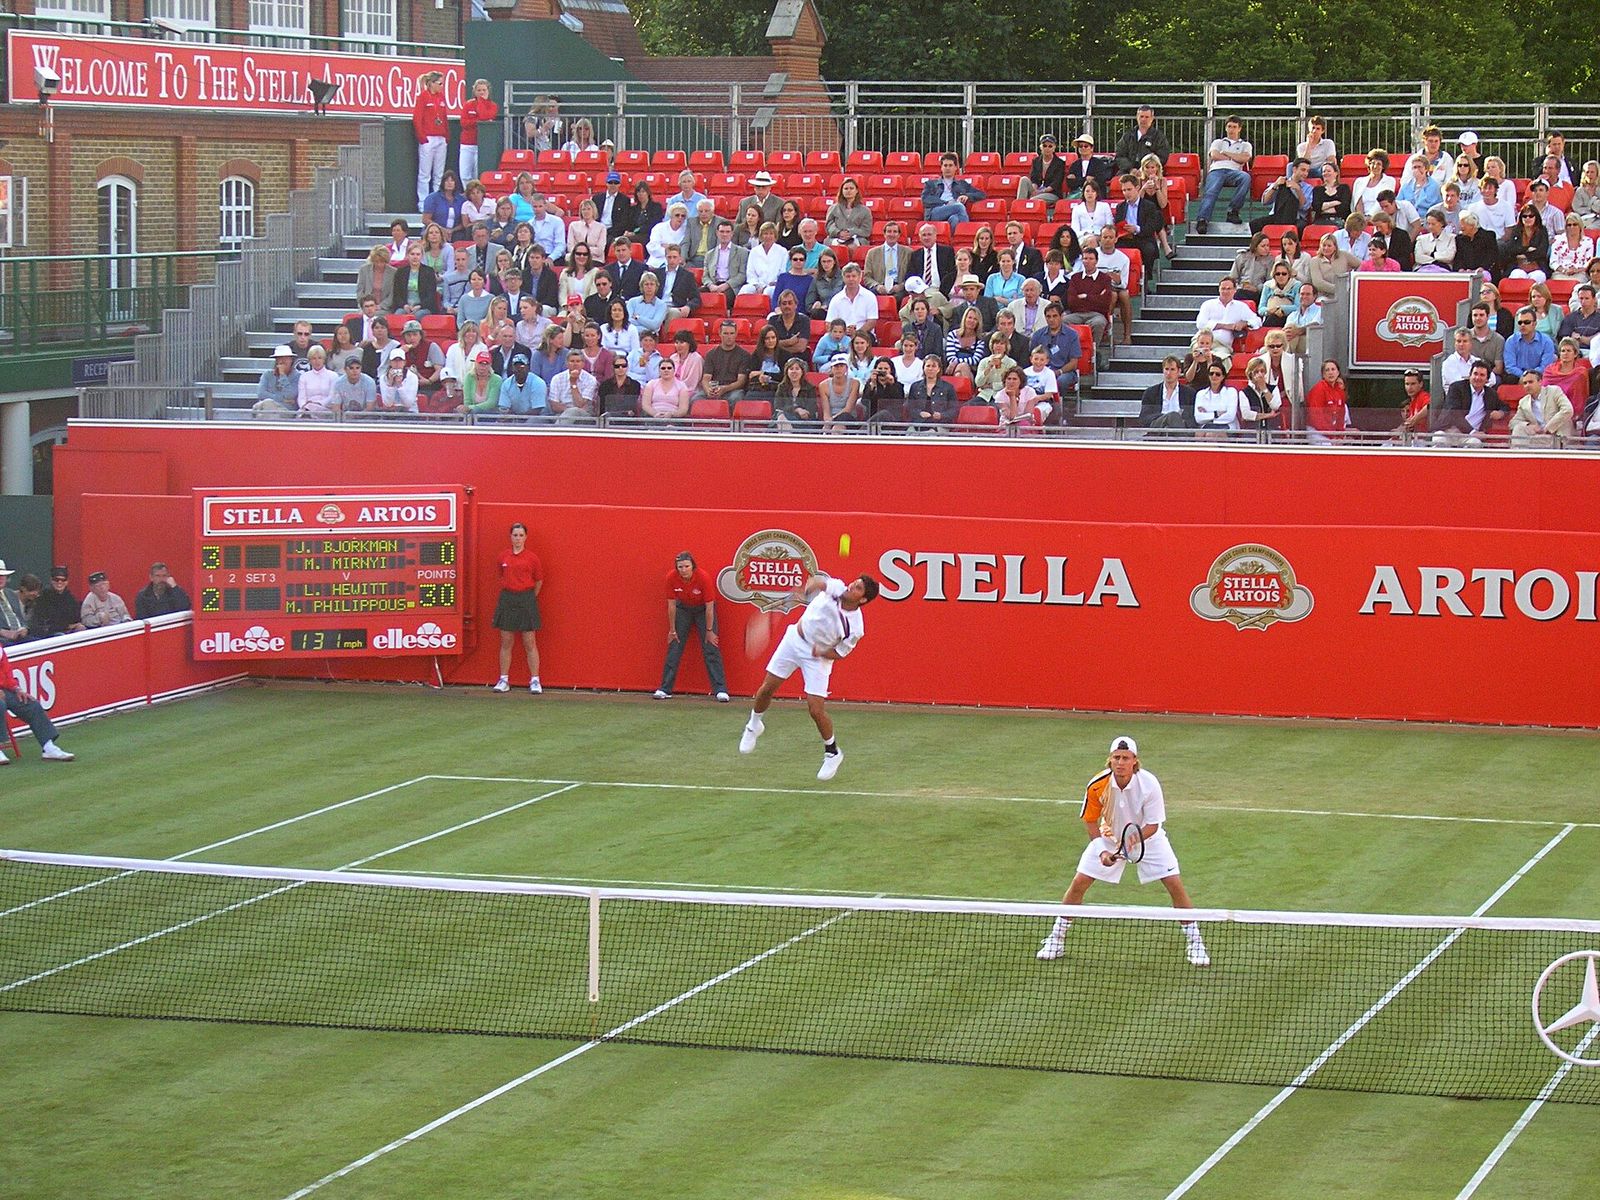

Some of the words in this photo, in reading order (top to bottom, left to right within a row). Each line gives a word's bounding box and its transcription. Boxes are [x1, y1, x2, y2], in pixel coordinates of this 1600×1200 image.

[155, 52, 188, 99] TO
[193, 55, 239, 101] THE
[243, 56, 315, 104] STELLA
[1395, 315, 1430, 323] STELLA
[1395, 323, 1430, 331] ARTOIS
[223, 508, 304, 525] STELLA
[357, 506, 437, 523] ARTOIS
[295, 541, 311, 554] J.
[323, 540, 397, 553] BJORKMAN
[440, 542, 455, 565] 0
[202, 546, 220, 569] 3
[304, 558, 321, 570] M.
[332, 557, 387, 569] MIRNYI
[417, 569, 457, 580] POINTS
[749, 561, 803, 575] STELLA
[208, 574, 214, 583] 1
[229, 573, 236, 583] 2
[246, 573, 267, 583] SET
[269, 573, 276, 583] 3
[342, 571, 351, 581] V
[748, 574, 803, 587] ARTOIS
[304, 584, 321, 596] L.
[332, 583, 388, 596] HEWITT
[878, 549, 1141, 608] STELLA
[1358, 565, 1600, 622] ARTOI
[1223, 577, 1280, 590] STELLA
[202, 588, 220, 611] 2
[419, 583, 455, 607] 30
[1223, 590, 1281, 602] ARTOIS
[286, 601, 302, 613] M.
[313, 599, 406, 612] PHILIPPOUS
[200, 632, 286, 653] ellesse
[343, 640, 363, 649] mph
[373, 628, 457, 649] ellesse
